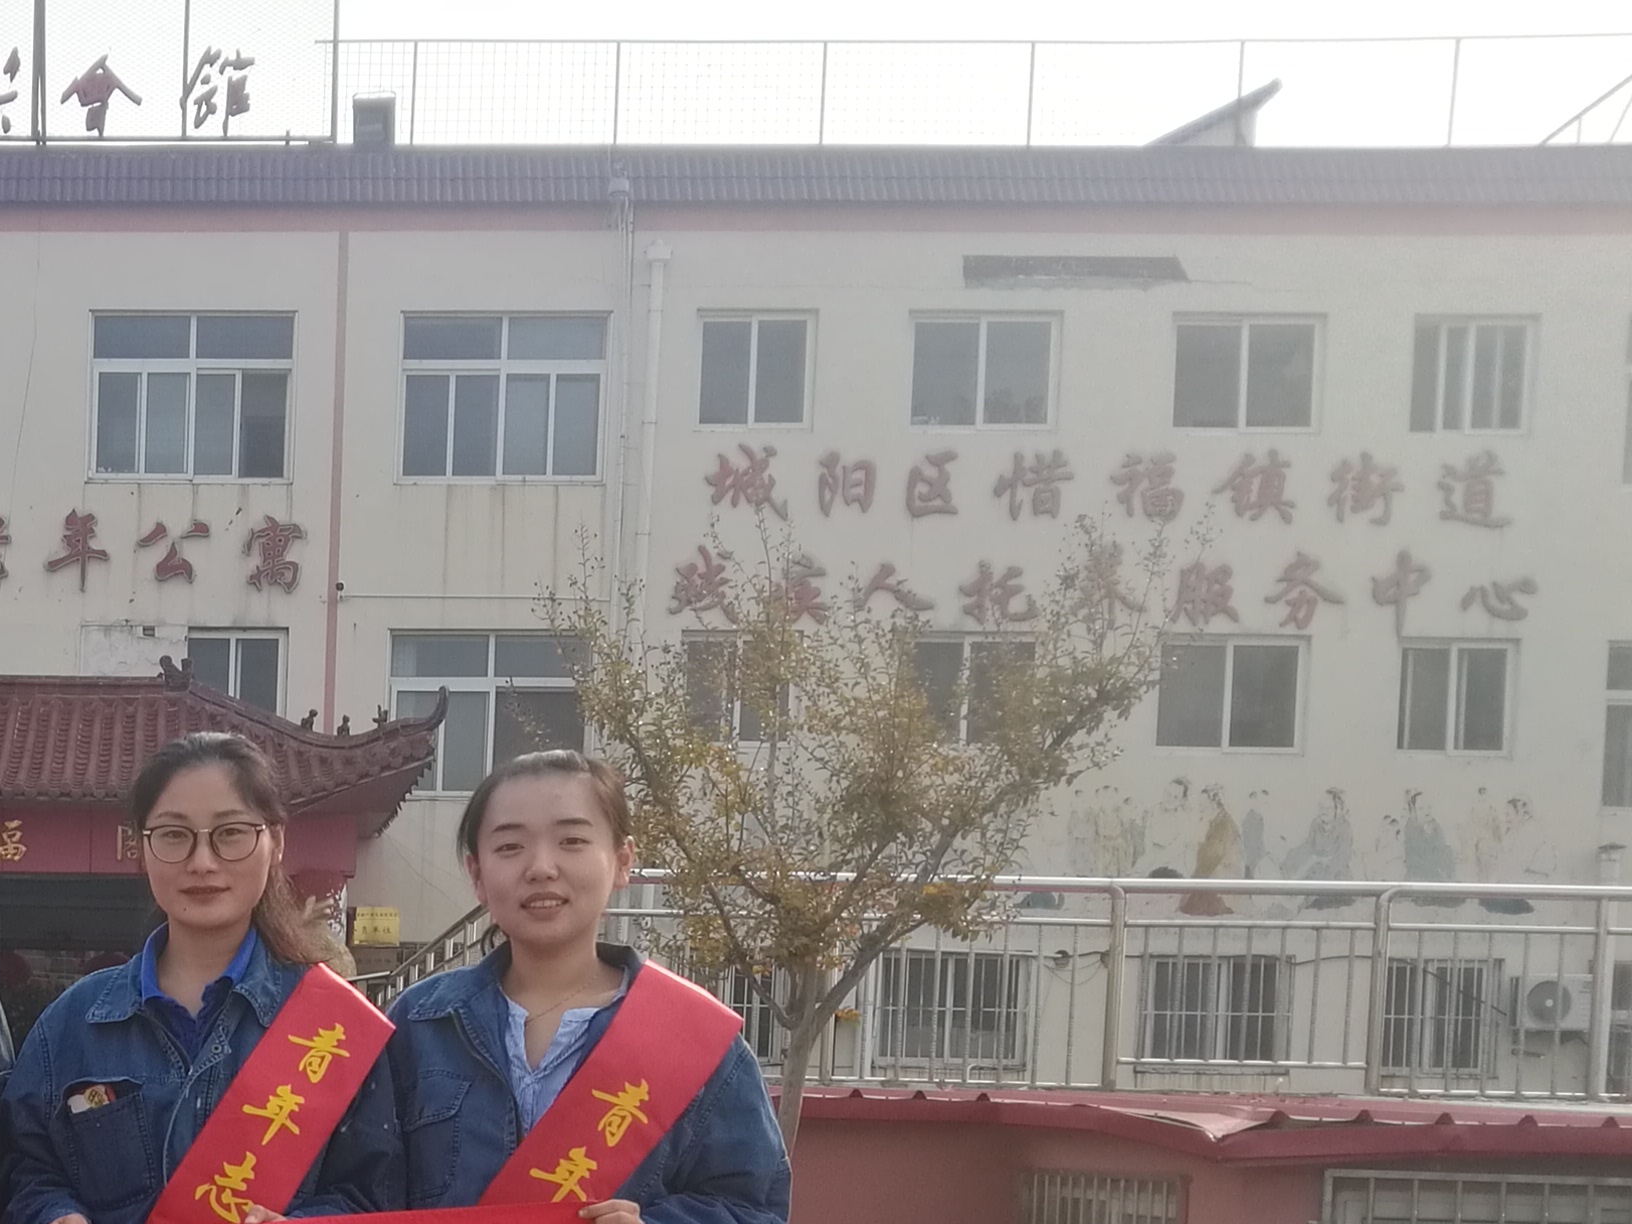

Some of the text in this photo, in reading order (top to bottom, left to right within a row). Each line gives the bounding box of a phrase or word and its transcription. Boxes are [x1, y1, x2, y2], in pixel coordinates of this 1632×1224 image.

[704, 443, 1517, 529] 城阳区惜福镇街道
[529, 1078, 649, 1203] 青年
